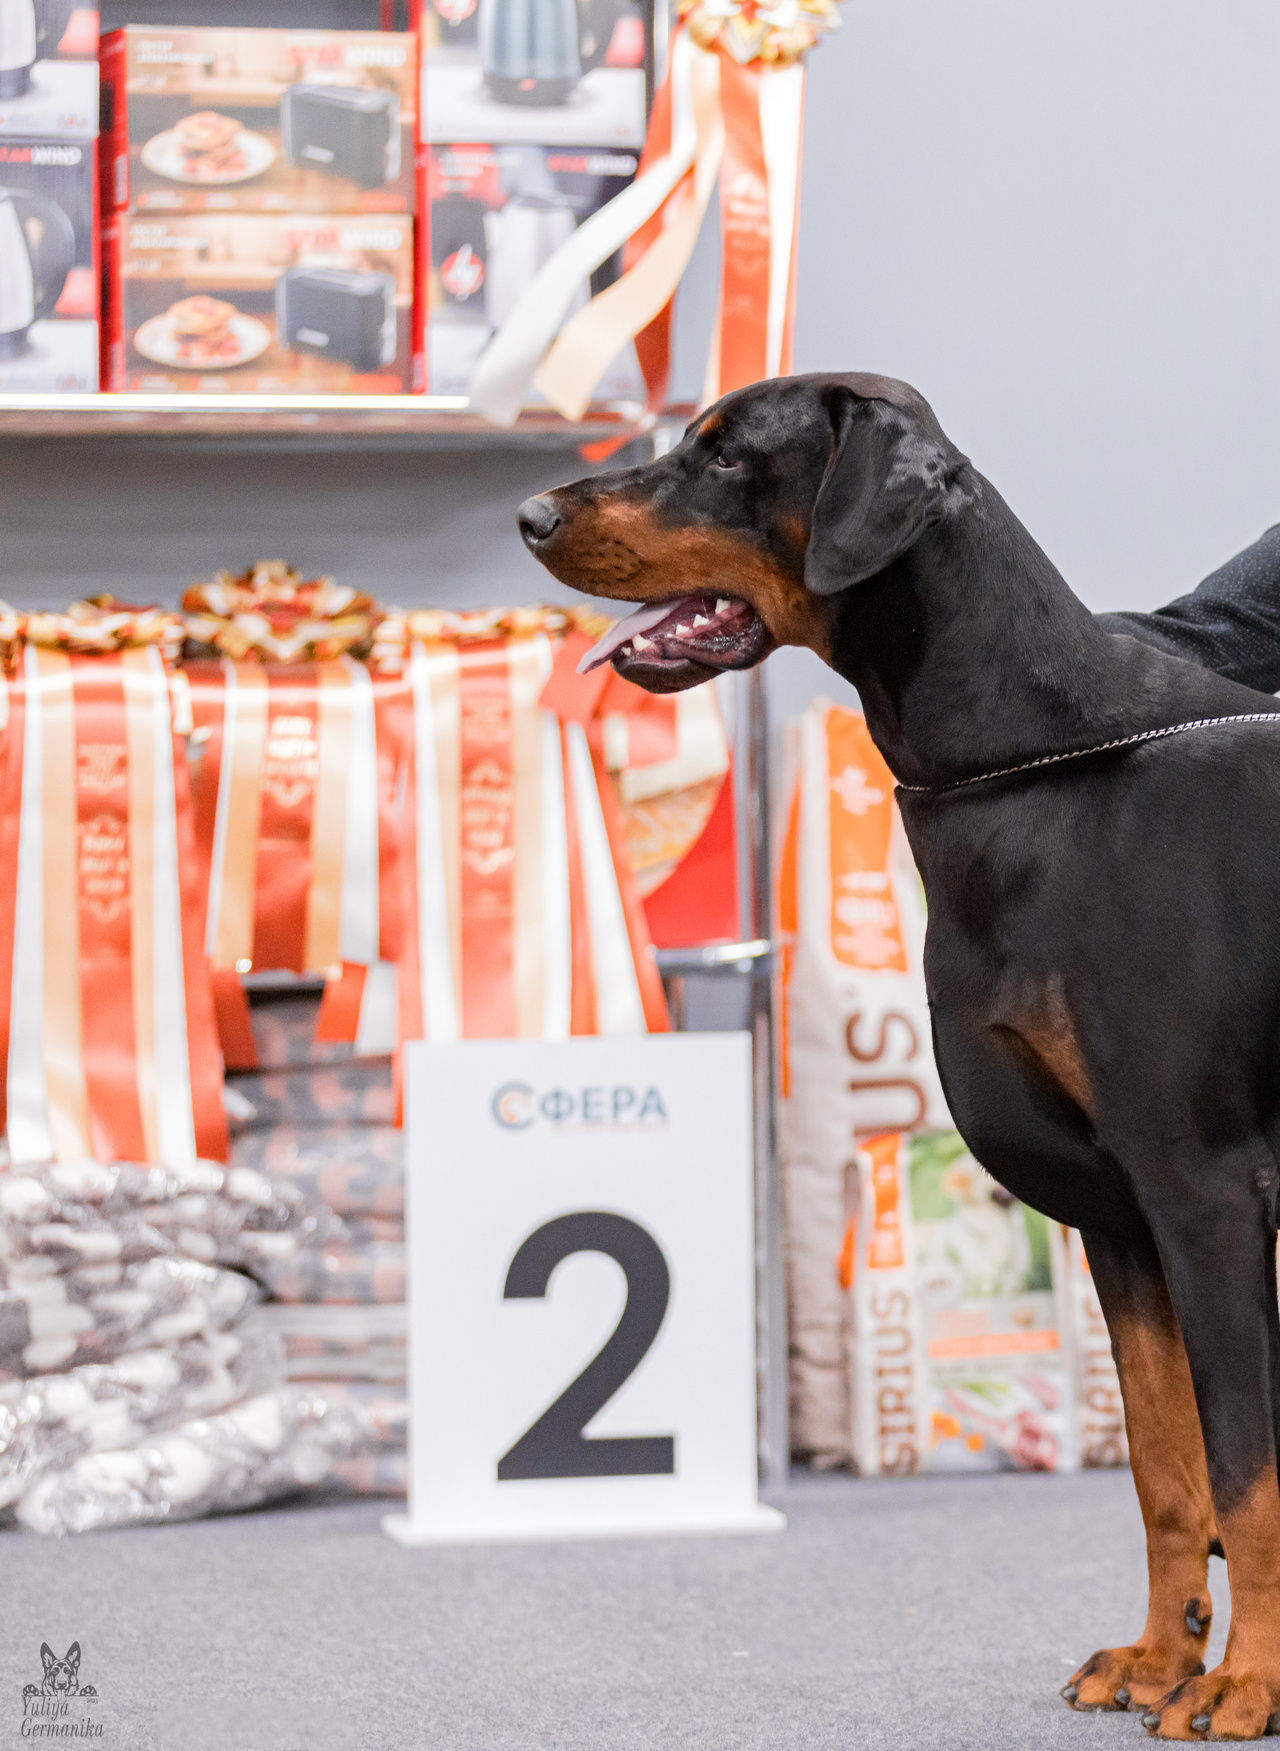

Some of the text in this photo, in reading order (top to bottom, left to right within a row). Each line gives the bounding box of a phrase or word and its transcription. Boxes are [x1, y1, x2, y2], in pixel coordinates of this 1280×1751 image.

[491, 1081, 670, 1132] СФЕРА
[496, 1211, 675, 1481] 2
[871, 1287, 920, 1476] SIRIUS
